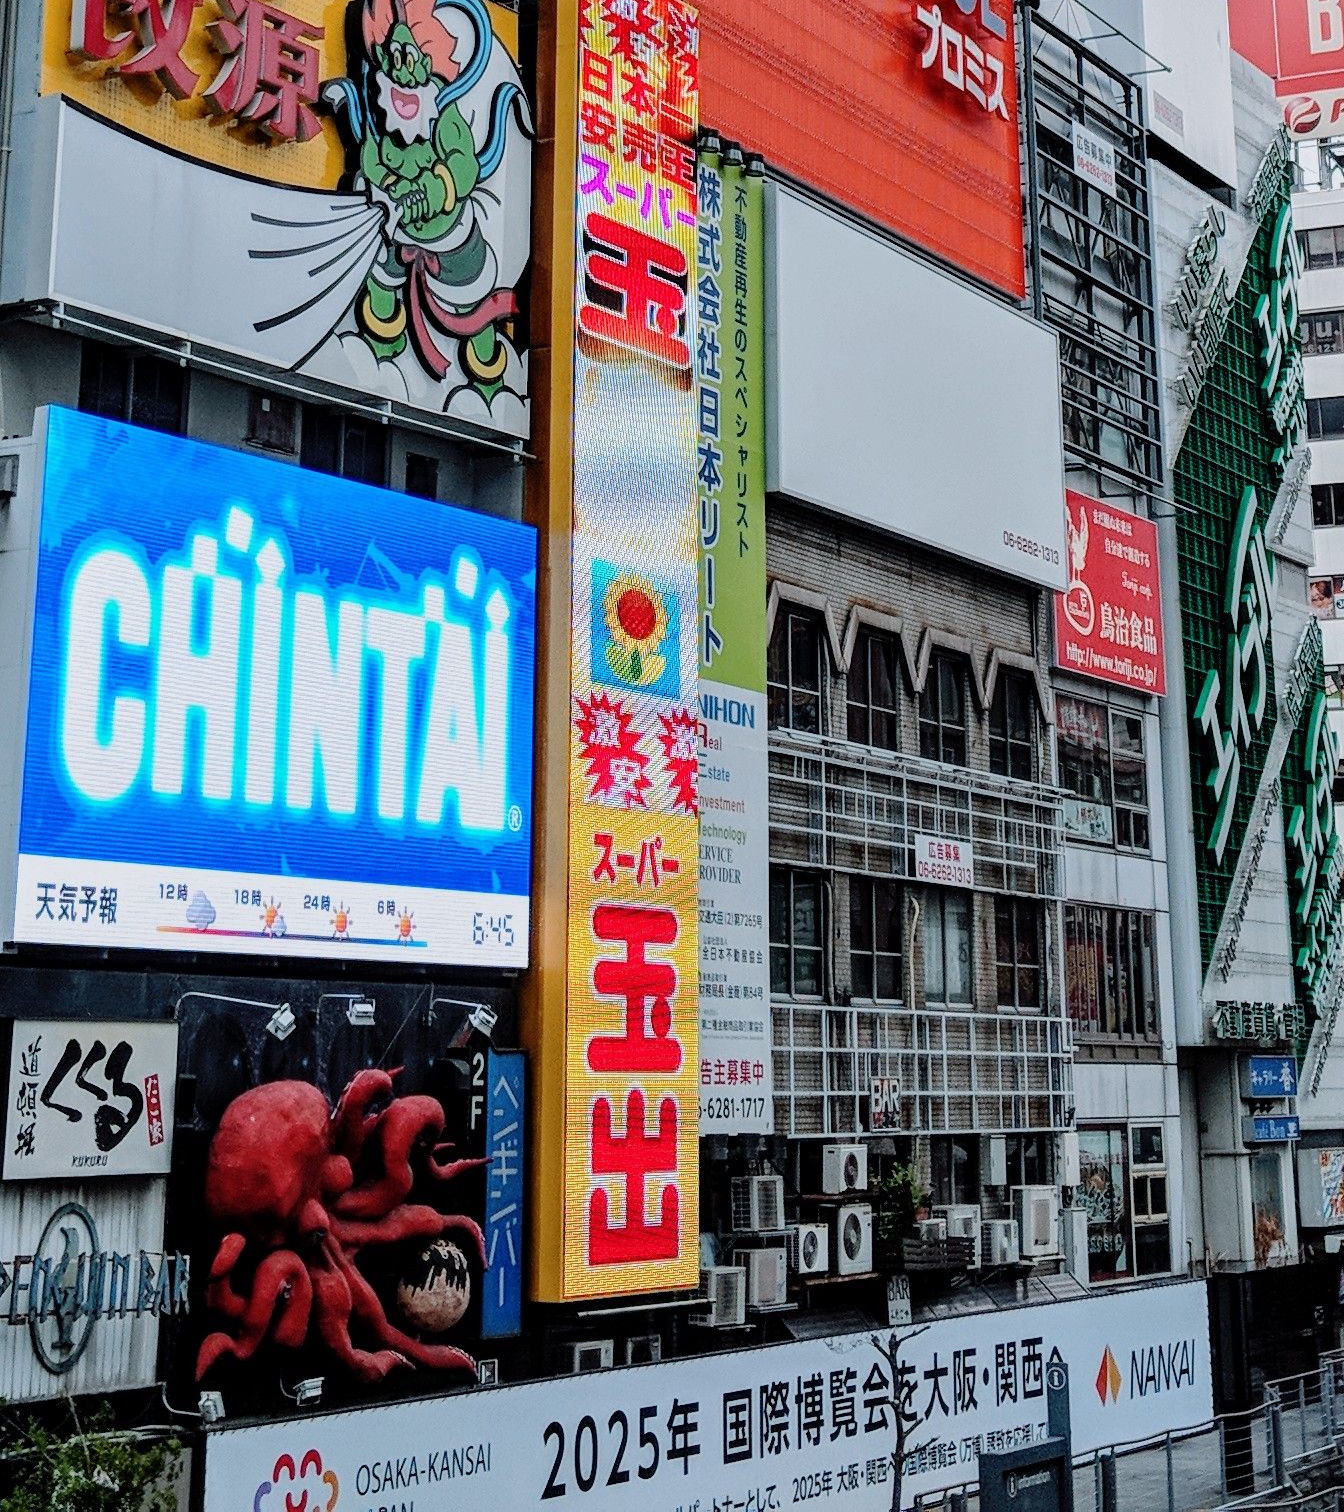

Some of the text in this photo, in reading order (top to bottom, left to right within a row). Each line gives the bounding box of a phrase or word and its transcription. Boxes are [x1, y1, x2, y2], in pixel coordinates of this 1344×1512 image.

[914, 3, 1011, 122] プロミス
[580, 153, 696, 230] スーパー
[697, 166, 724, 665] 株式会社日本リート
[1003, 530, 1060, 566] 06-6262-1313
[592, 832, 681, 890] スーパー
[35, 881, 119, 926] 天気予報
[158, 883, 397, 916] 12時 18時 24時 6時
[472, 911, 515, 947] 6:45
[40, 1038, 144, 1153] くくる
[487, 1075, 520, 1309] ペンギンバー
[1130, 1338, 1196, 1400] NANKAI
[356, 1443, 492, 1496] OSAKA-KANSAI
[539, 1397, 701, 1501] 2025年
